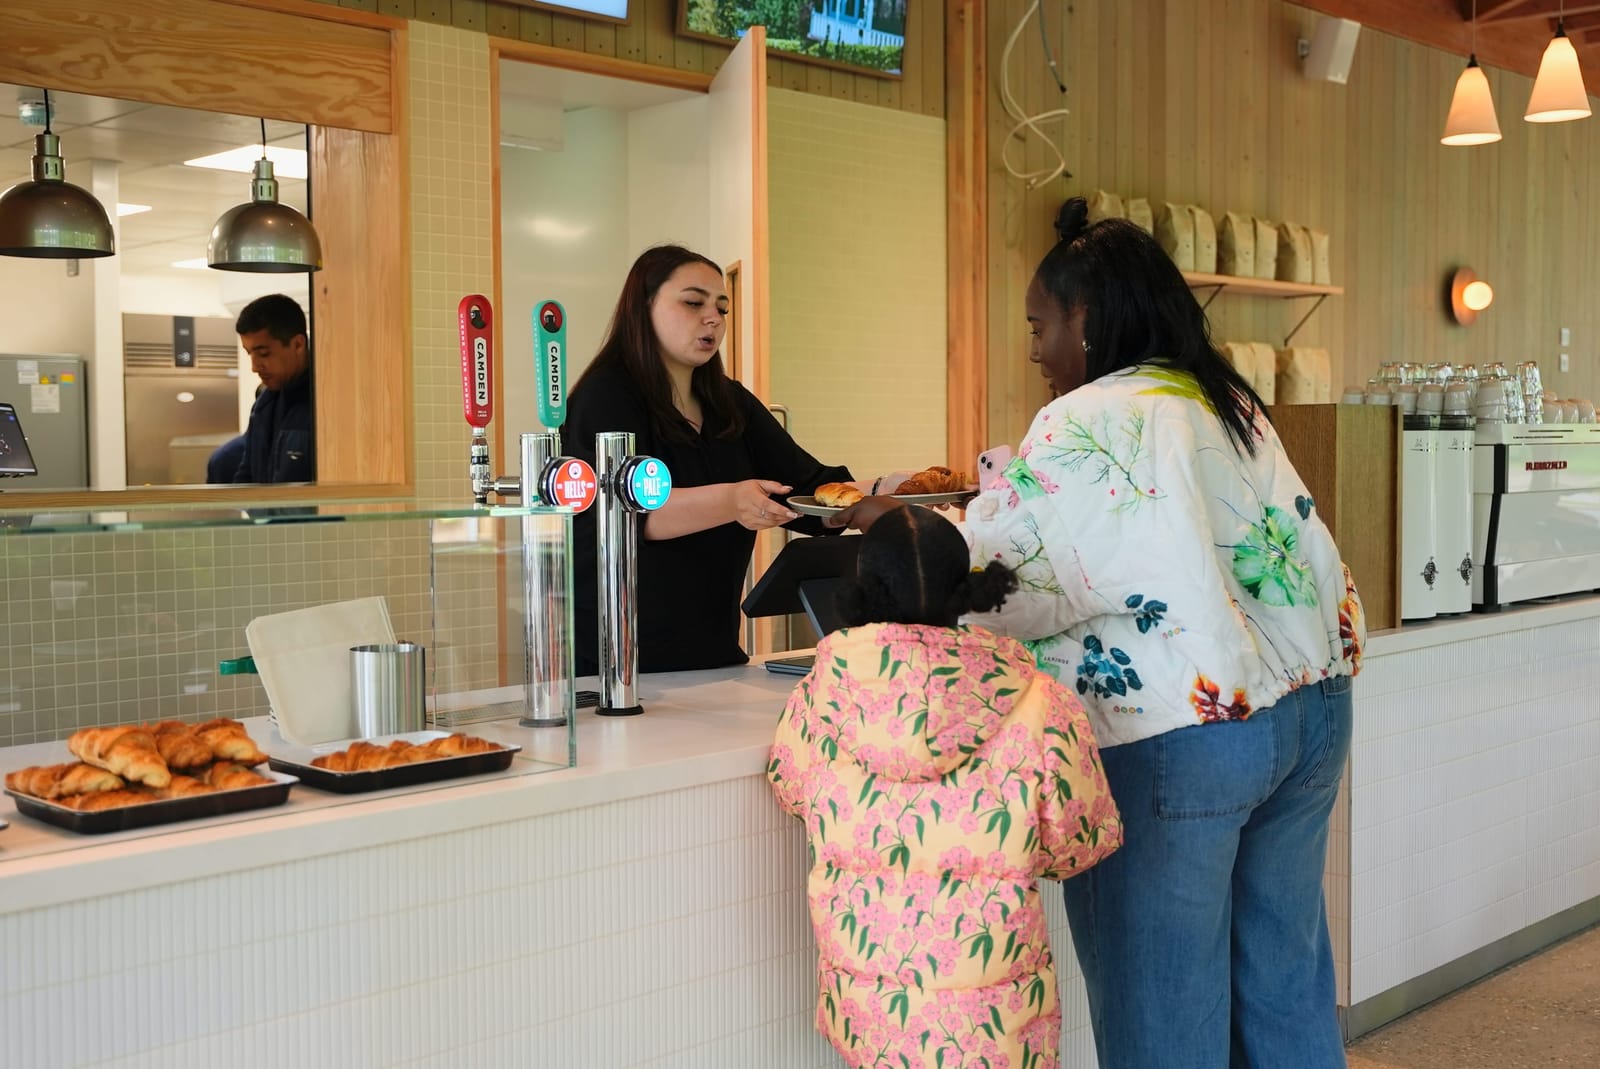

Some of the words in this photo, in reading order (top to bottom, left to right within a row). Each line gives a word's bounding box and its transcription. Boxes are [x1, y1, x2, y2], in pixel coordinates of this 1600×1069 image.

[477, 342, 486, 400] CAMDEN
[550, 346, 559, 402] CAMDEN
[564, 480, 587, 499] HELLS
[643, 478, 661, 497] PALE
